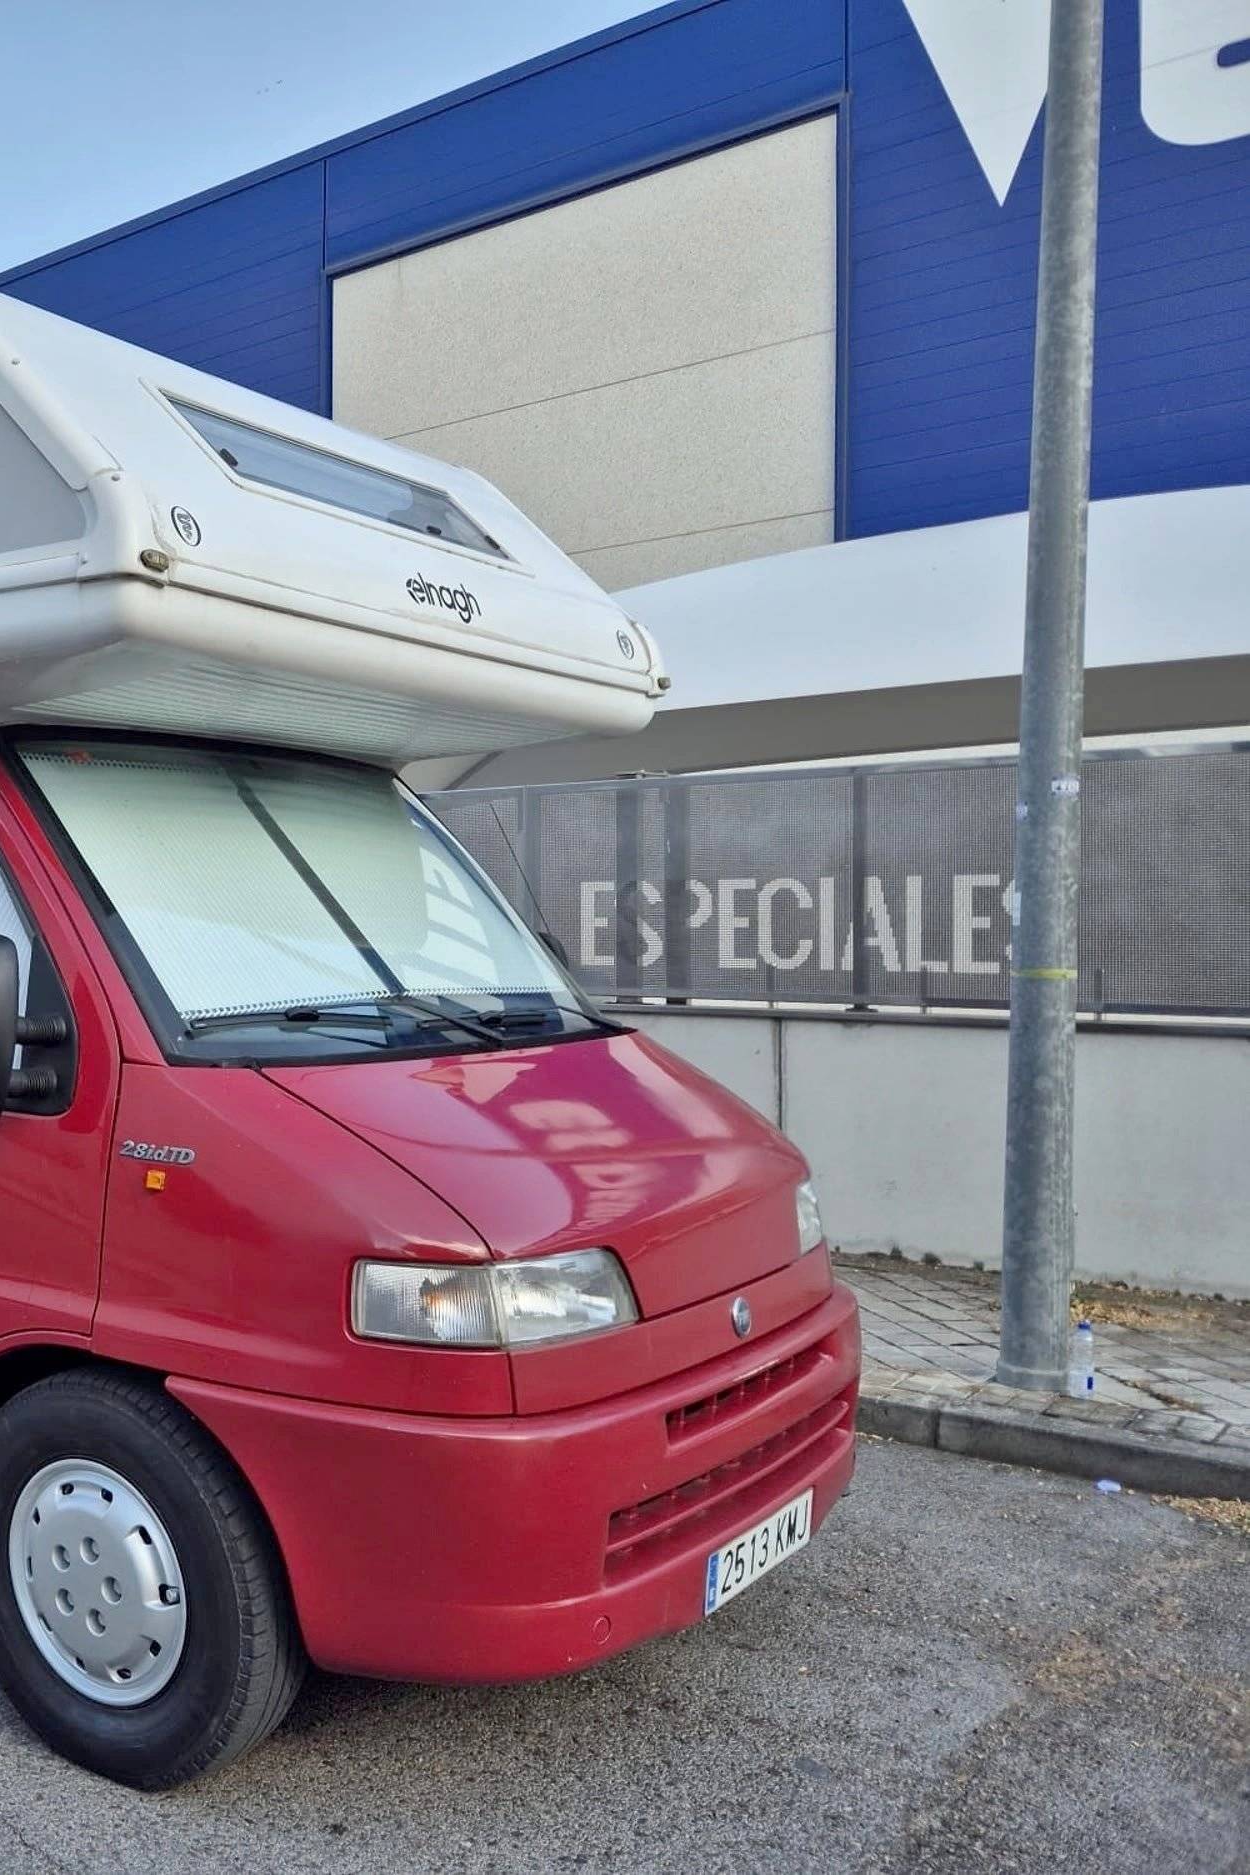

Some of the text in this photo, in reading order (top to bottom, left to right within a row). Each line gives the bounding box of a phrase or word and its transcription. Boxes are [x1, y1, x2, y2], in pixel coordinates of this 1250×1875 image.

[405, 572, 482, 624] elnagh
[580, 873, 1015, 974] ESPECIALE
[721, 1499, 809, 1595] 2513 KMJ
